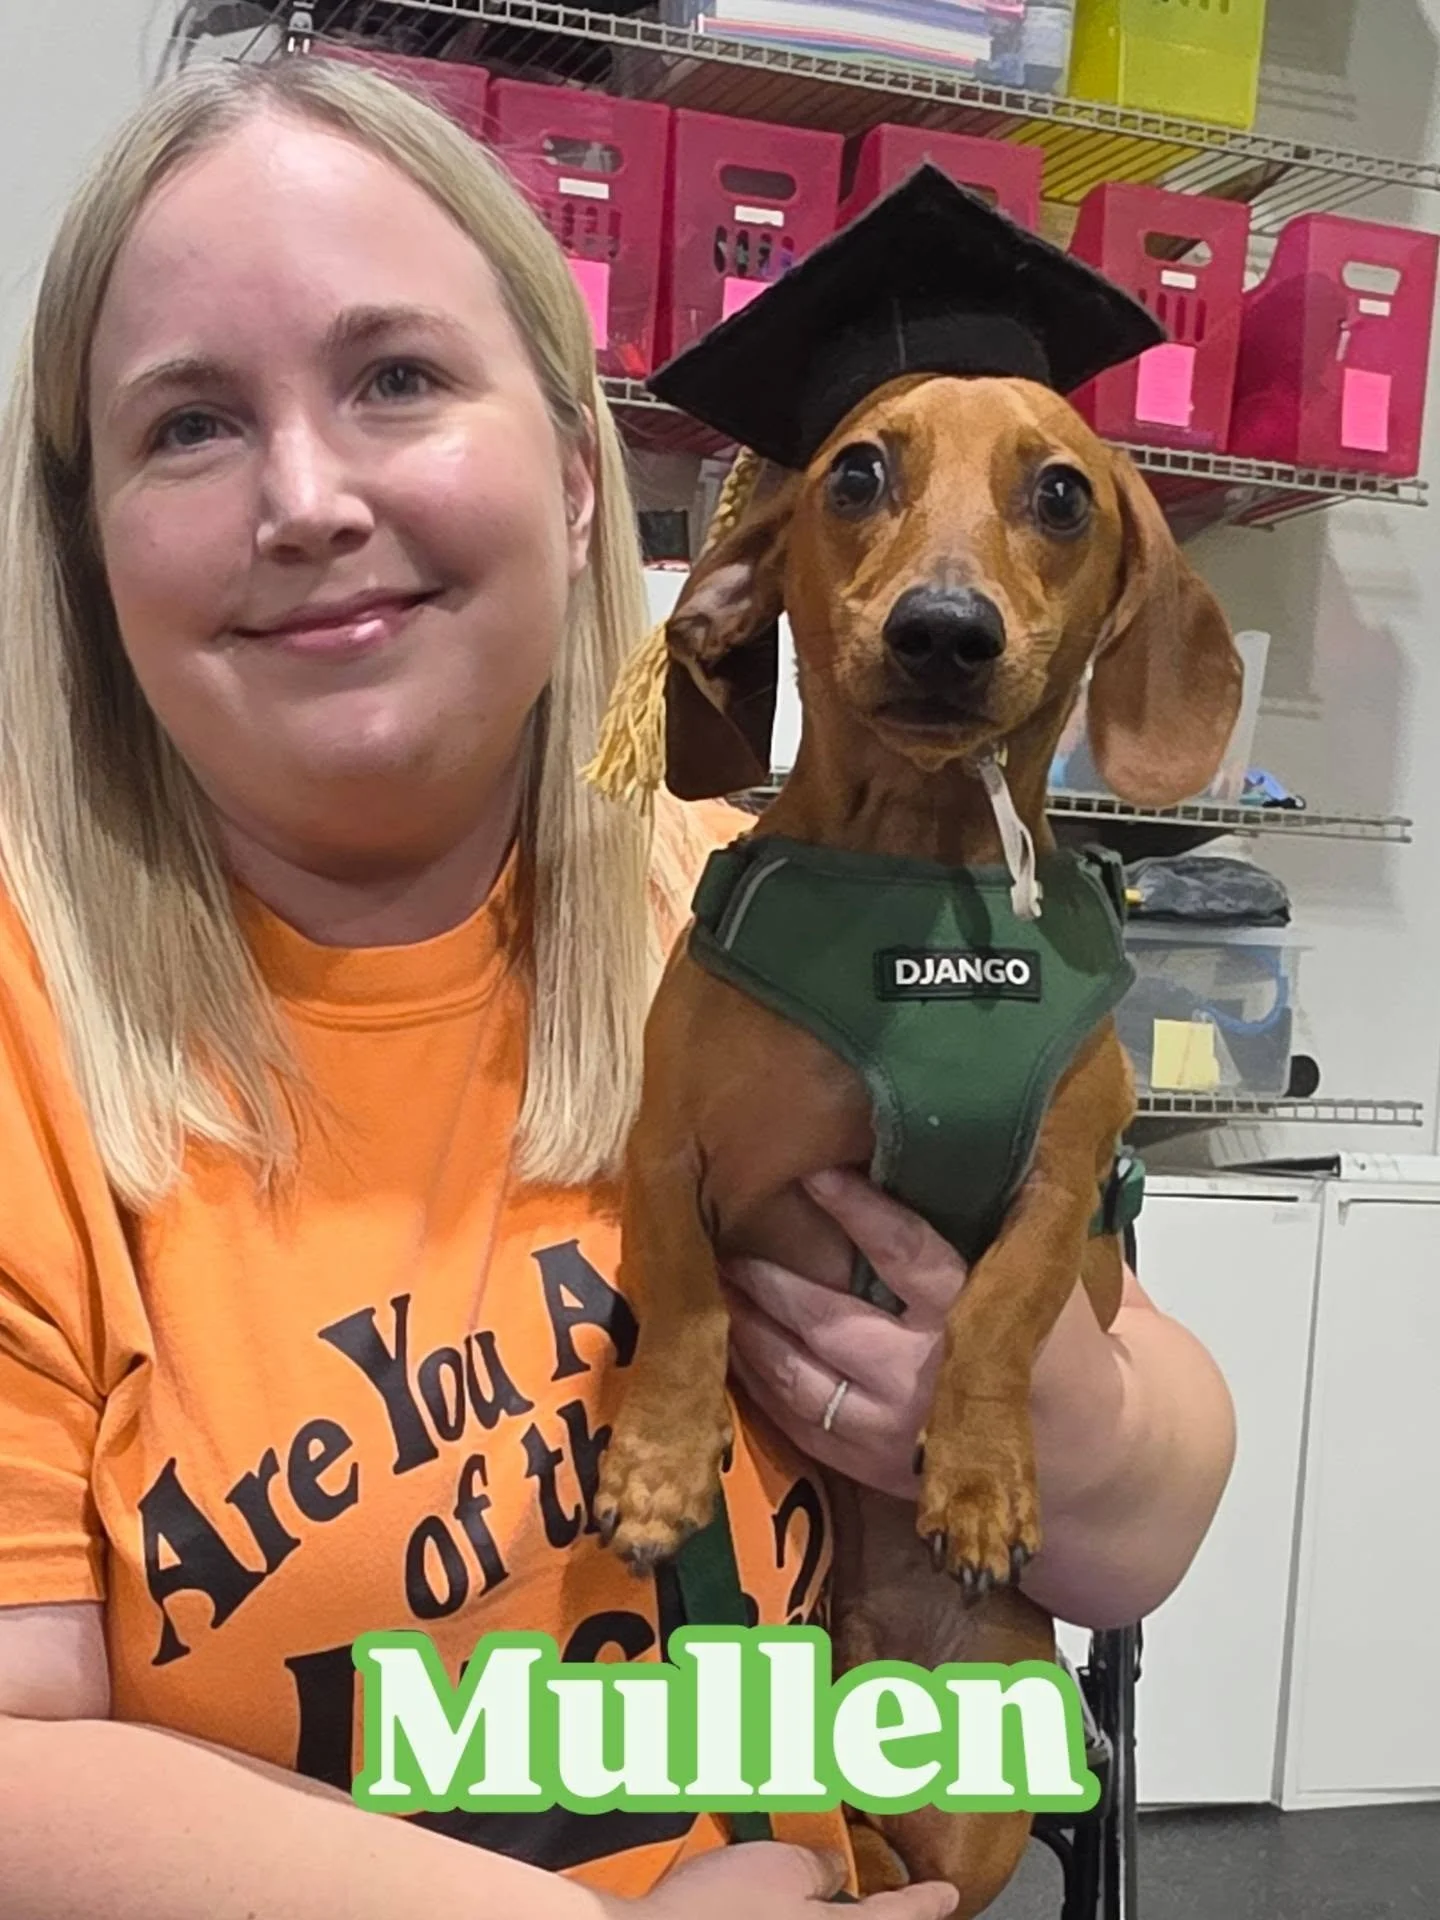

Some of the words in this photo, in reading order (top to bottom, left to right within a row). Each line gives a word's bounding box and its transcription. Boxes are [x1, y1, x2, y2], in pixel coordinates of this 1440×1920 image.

[894, 957, 1031, 986] DJANGO
[138, 1418, 359, 1667] Are
[317, 1293, 534, 1476] You
[404, 1453, 511, 1621] of
